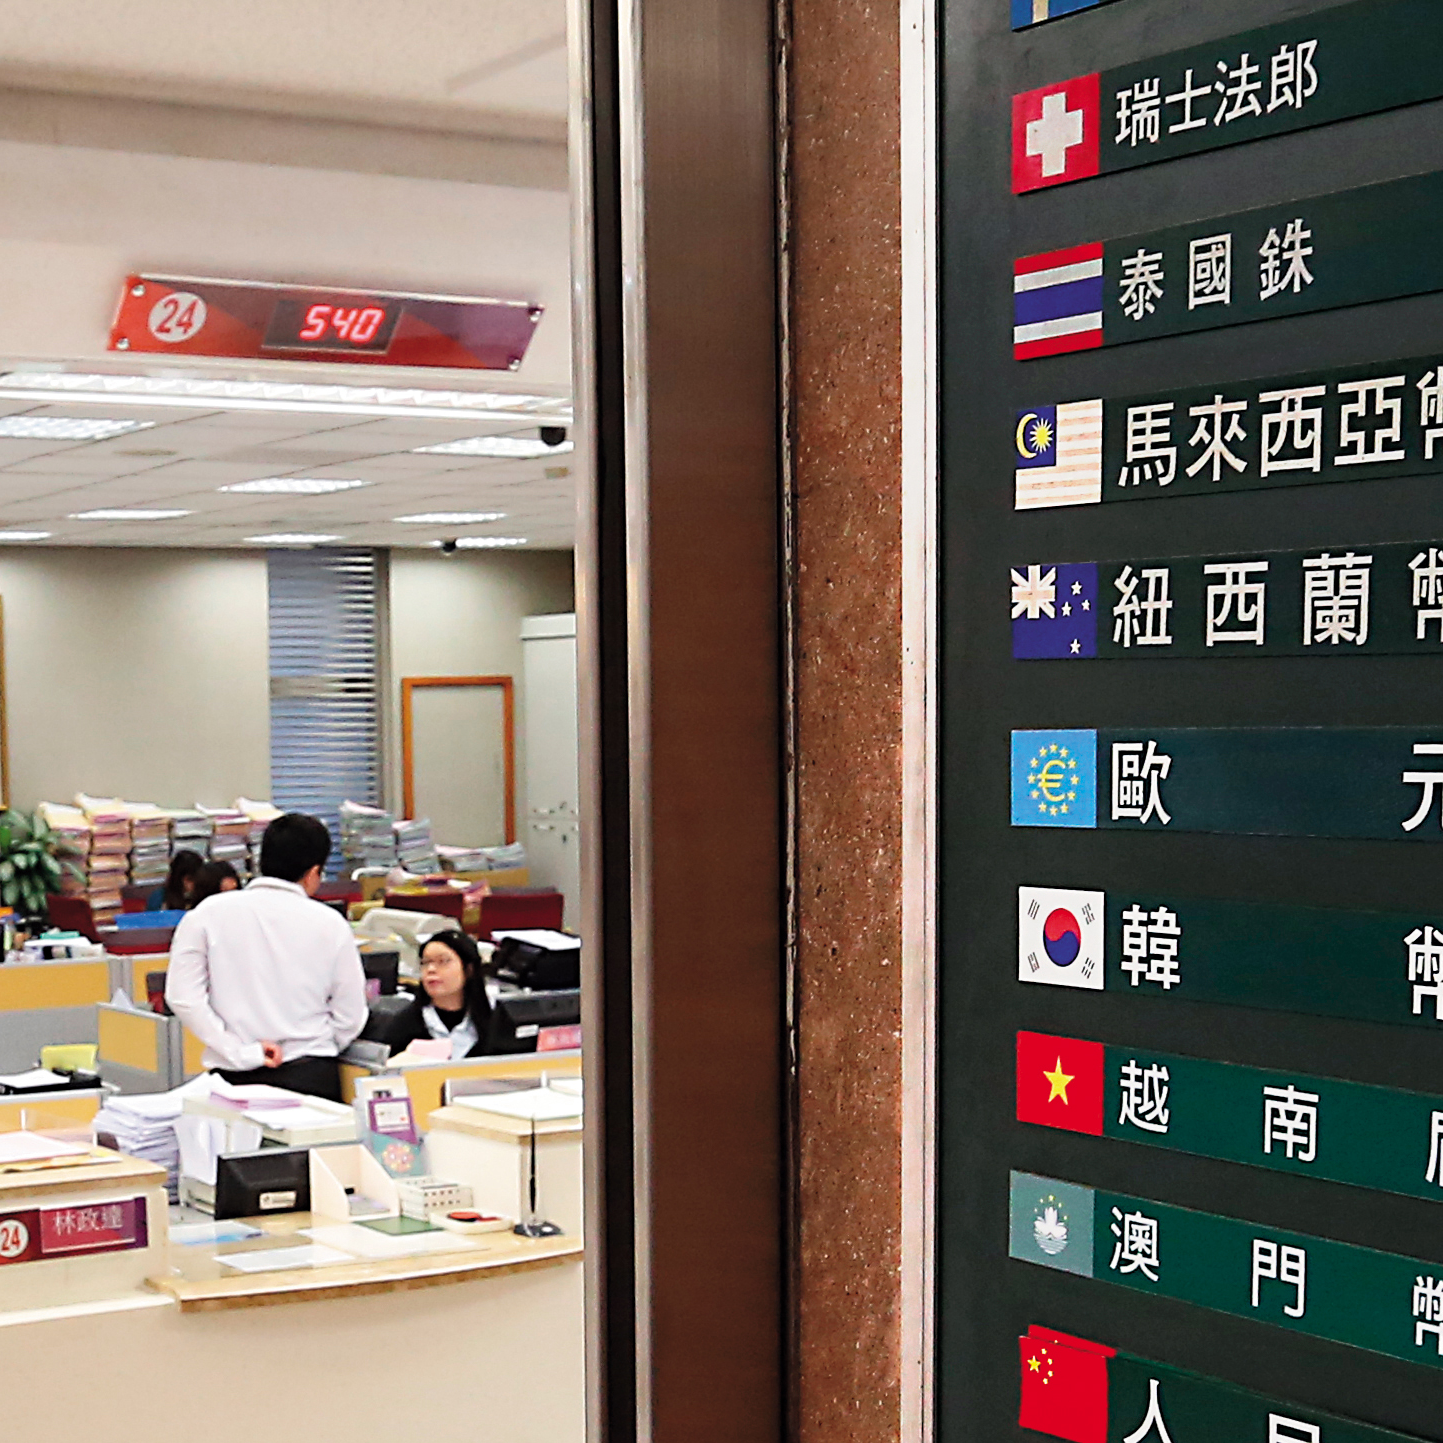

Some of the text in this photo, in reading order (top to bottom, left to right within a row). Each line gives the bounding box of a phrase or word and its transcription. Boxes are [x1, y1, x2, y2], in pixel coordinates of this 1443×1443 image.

[1116, 40, 1317, 146] 瑞士法郎
[1119, 219, 1313, 320] 泰國銖
[156, 302, 194, 334] 24
[300, 304, 386, 343] 540
[0, 1226, 21, 1252] 24
